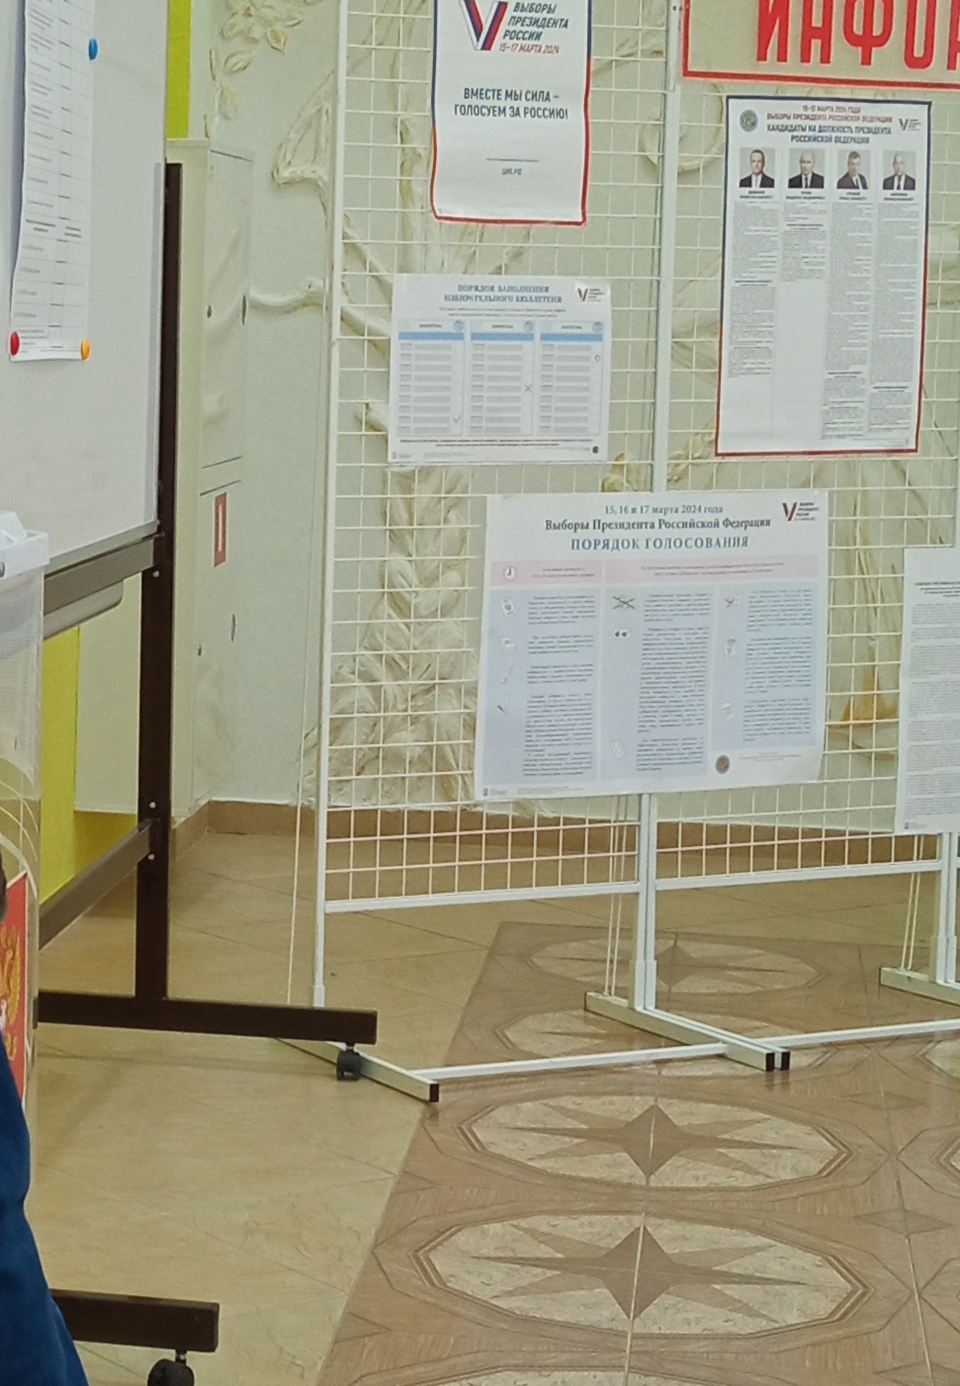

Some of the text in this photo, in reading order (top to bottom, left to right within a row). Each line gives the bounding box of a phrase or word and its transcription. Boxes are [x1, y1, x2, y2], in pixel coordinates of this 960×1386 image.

[513, 2, 557, 14] ВЫБОРЫ
[508, 16, 569, 29] ПРЕЗИДЕНТА
[502, 29, 543, 41] РОССИИ
[519, 44, 542, 53] МАРТА
[543, 45, 560, 54] 2024
[463, 88, 503, 101] ВМЕСТЕ
[505, 89, 523, 102] МЫ
[524, 91, 551, 103] СИЛА
[454, 104, 569, 120] ГОЛОСУЕМ ЗА РОССИЮ!
[767, 124, 807, 133] КАНДИДАТЫ
[818, 126, 853, 135] ДОЛЖНОСТЬ
[619, 505, 629, 514] 16
[640, 505, 649, 513] 17
[651, 507, 679, 516] марта
[681, 504, 702, 513] 2024
[703, 506, 723, 514] года
[545, 517, 771, 532] Выборы Президента Российской Федерации
[570, 536, 748, 551] ПОРЯДОК ГОЛОСОВАНИЯ
